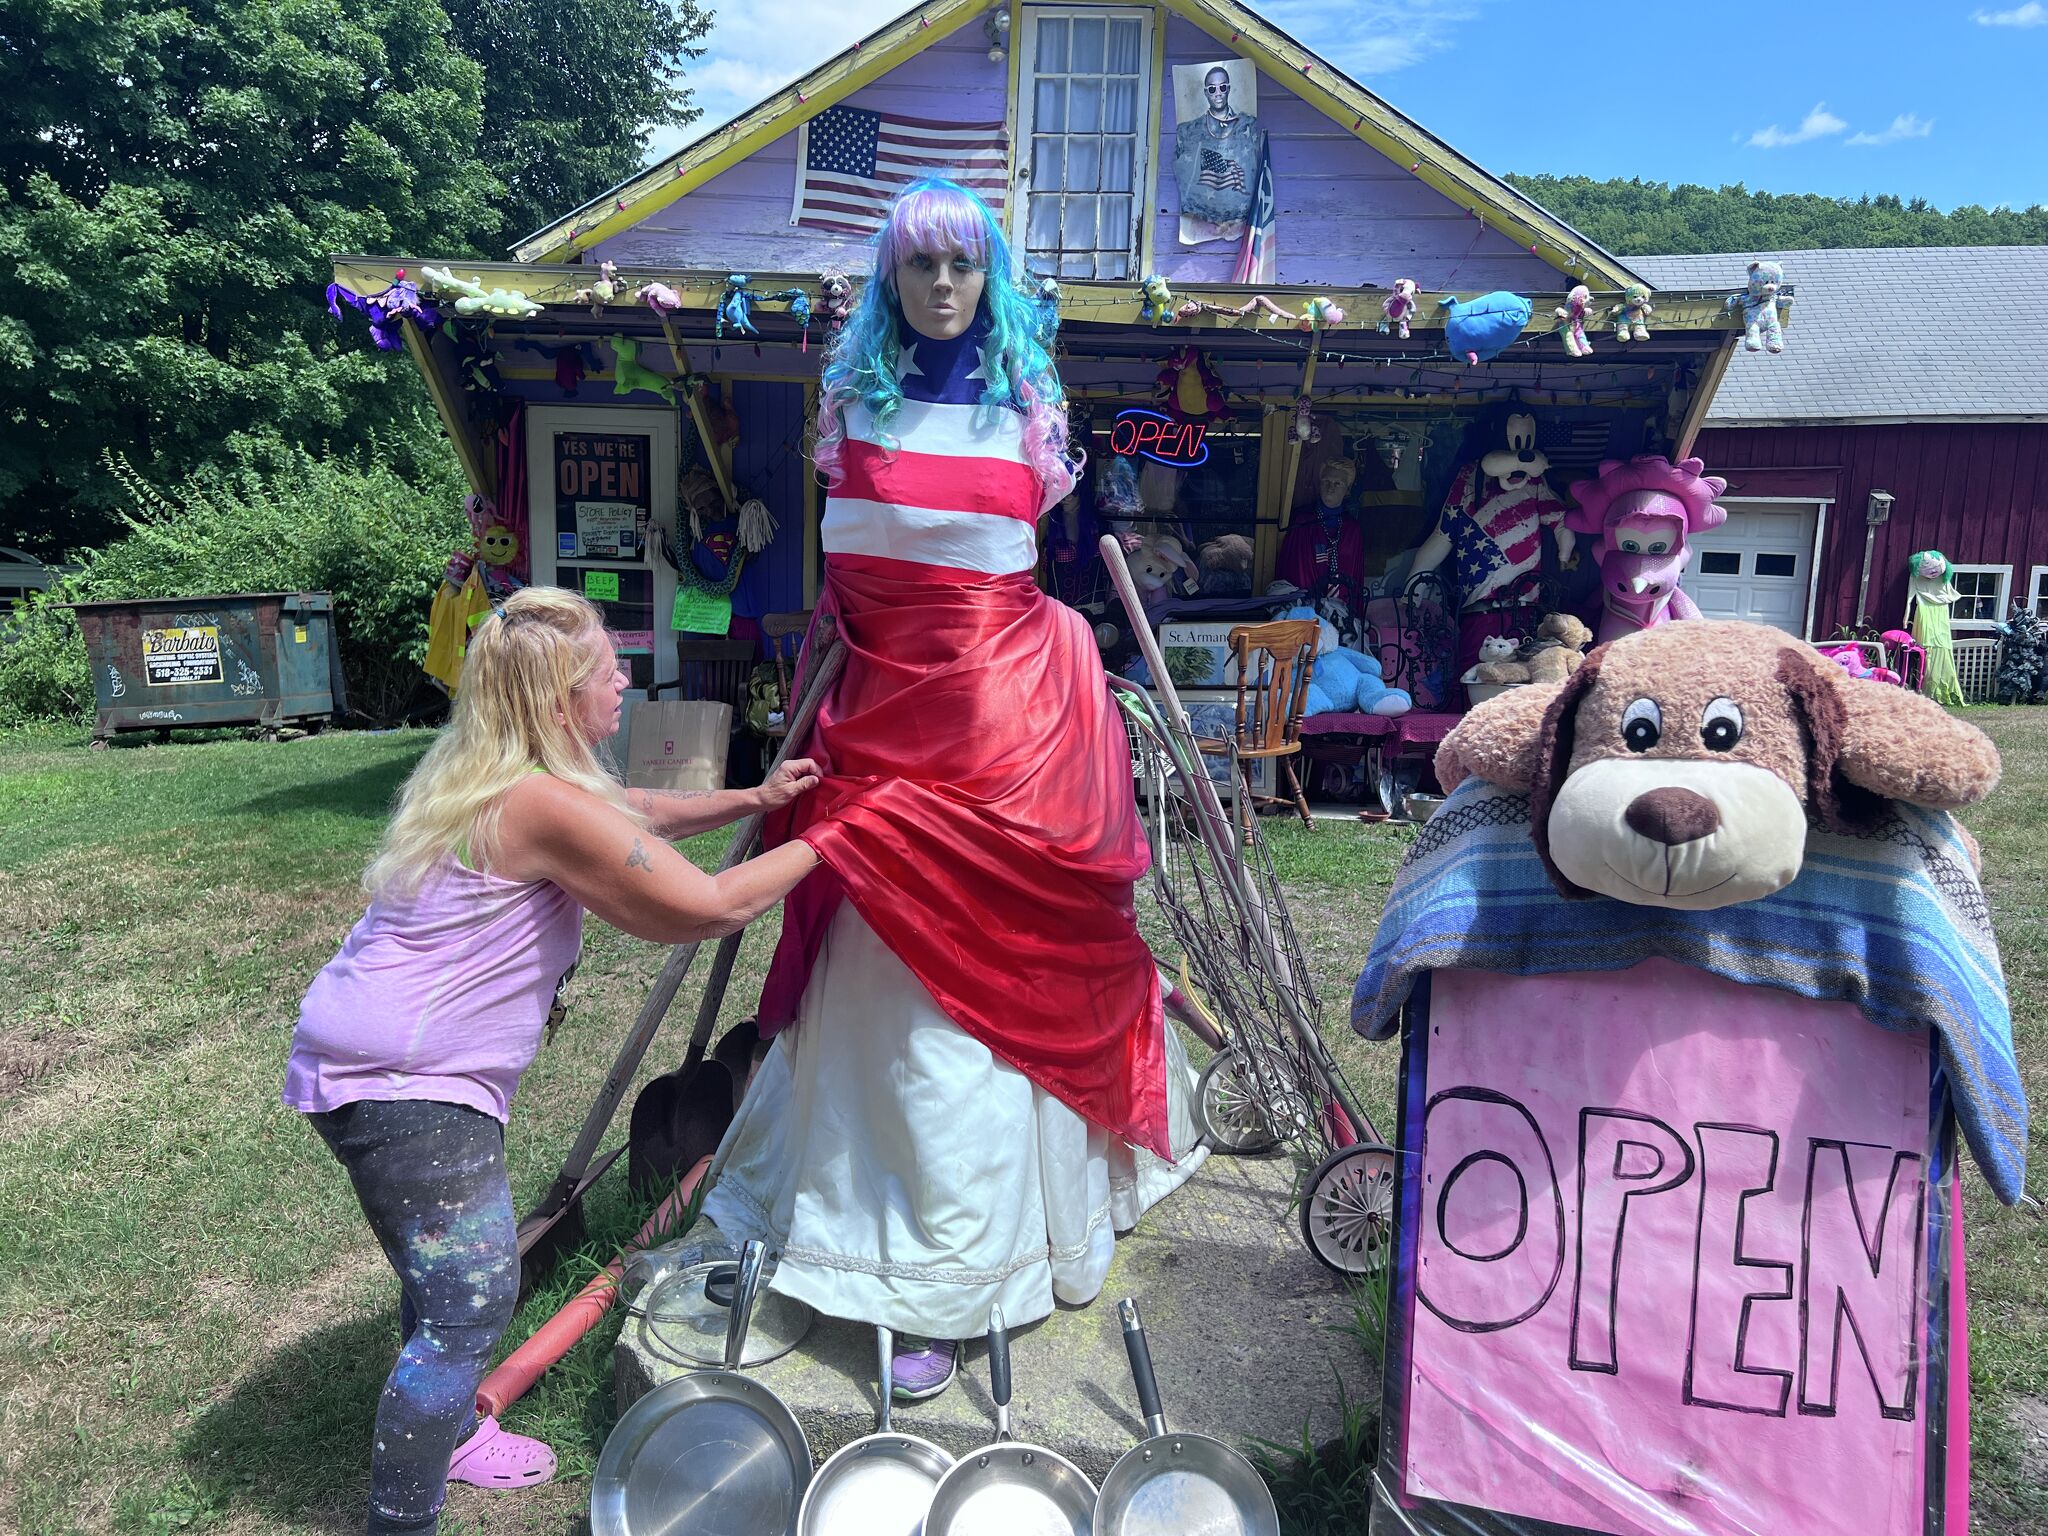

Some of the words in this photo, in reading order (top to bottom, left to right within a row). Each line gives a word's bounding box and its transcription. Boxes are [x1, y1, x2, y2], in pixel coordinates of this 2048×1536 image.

[1111, 420, 1205, 457] OPEN
[563, 441, 587, 456] YES
[593, 442, 635, 457] WE'RE
[560, 459, 639, 497] OPEN
[578, 506, 604, 518] STORE
[150, 630, 215, 653] Barbato
[1168, 630, 1184, 643] St.
[1186, 631, 1228, 643] Arman
[155, 666, 213, 678] 518-325-3331
[1414, 1086, 1924, 1422] OPEN
